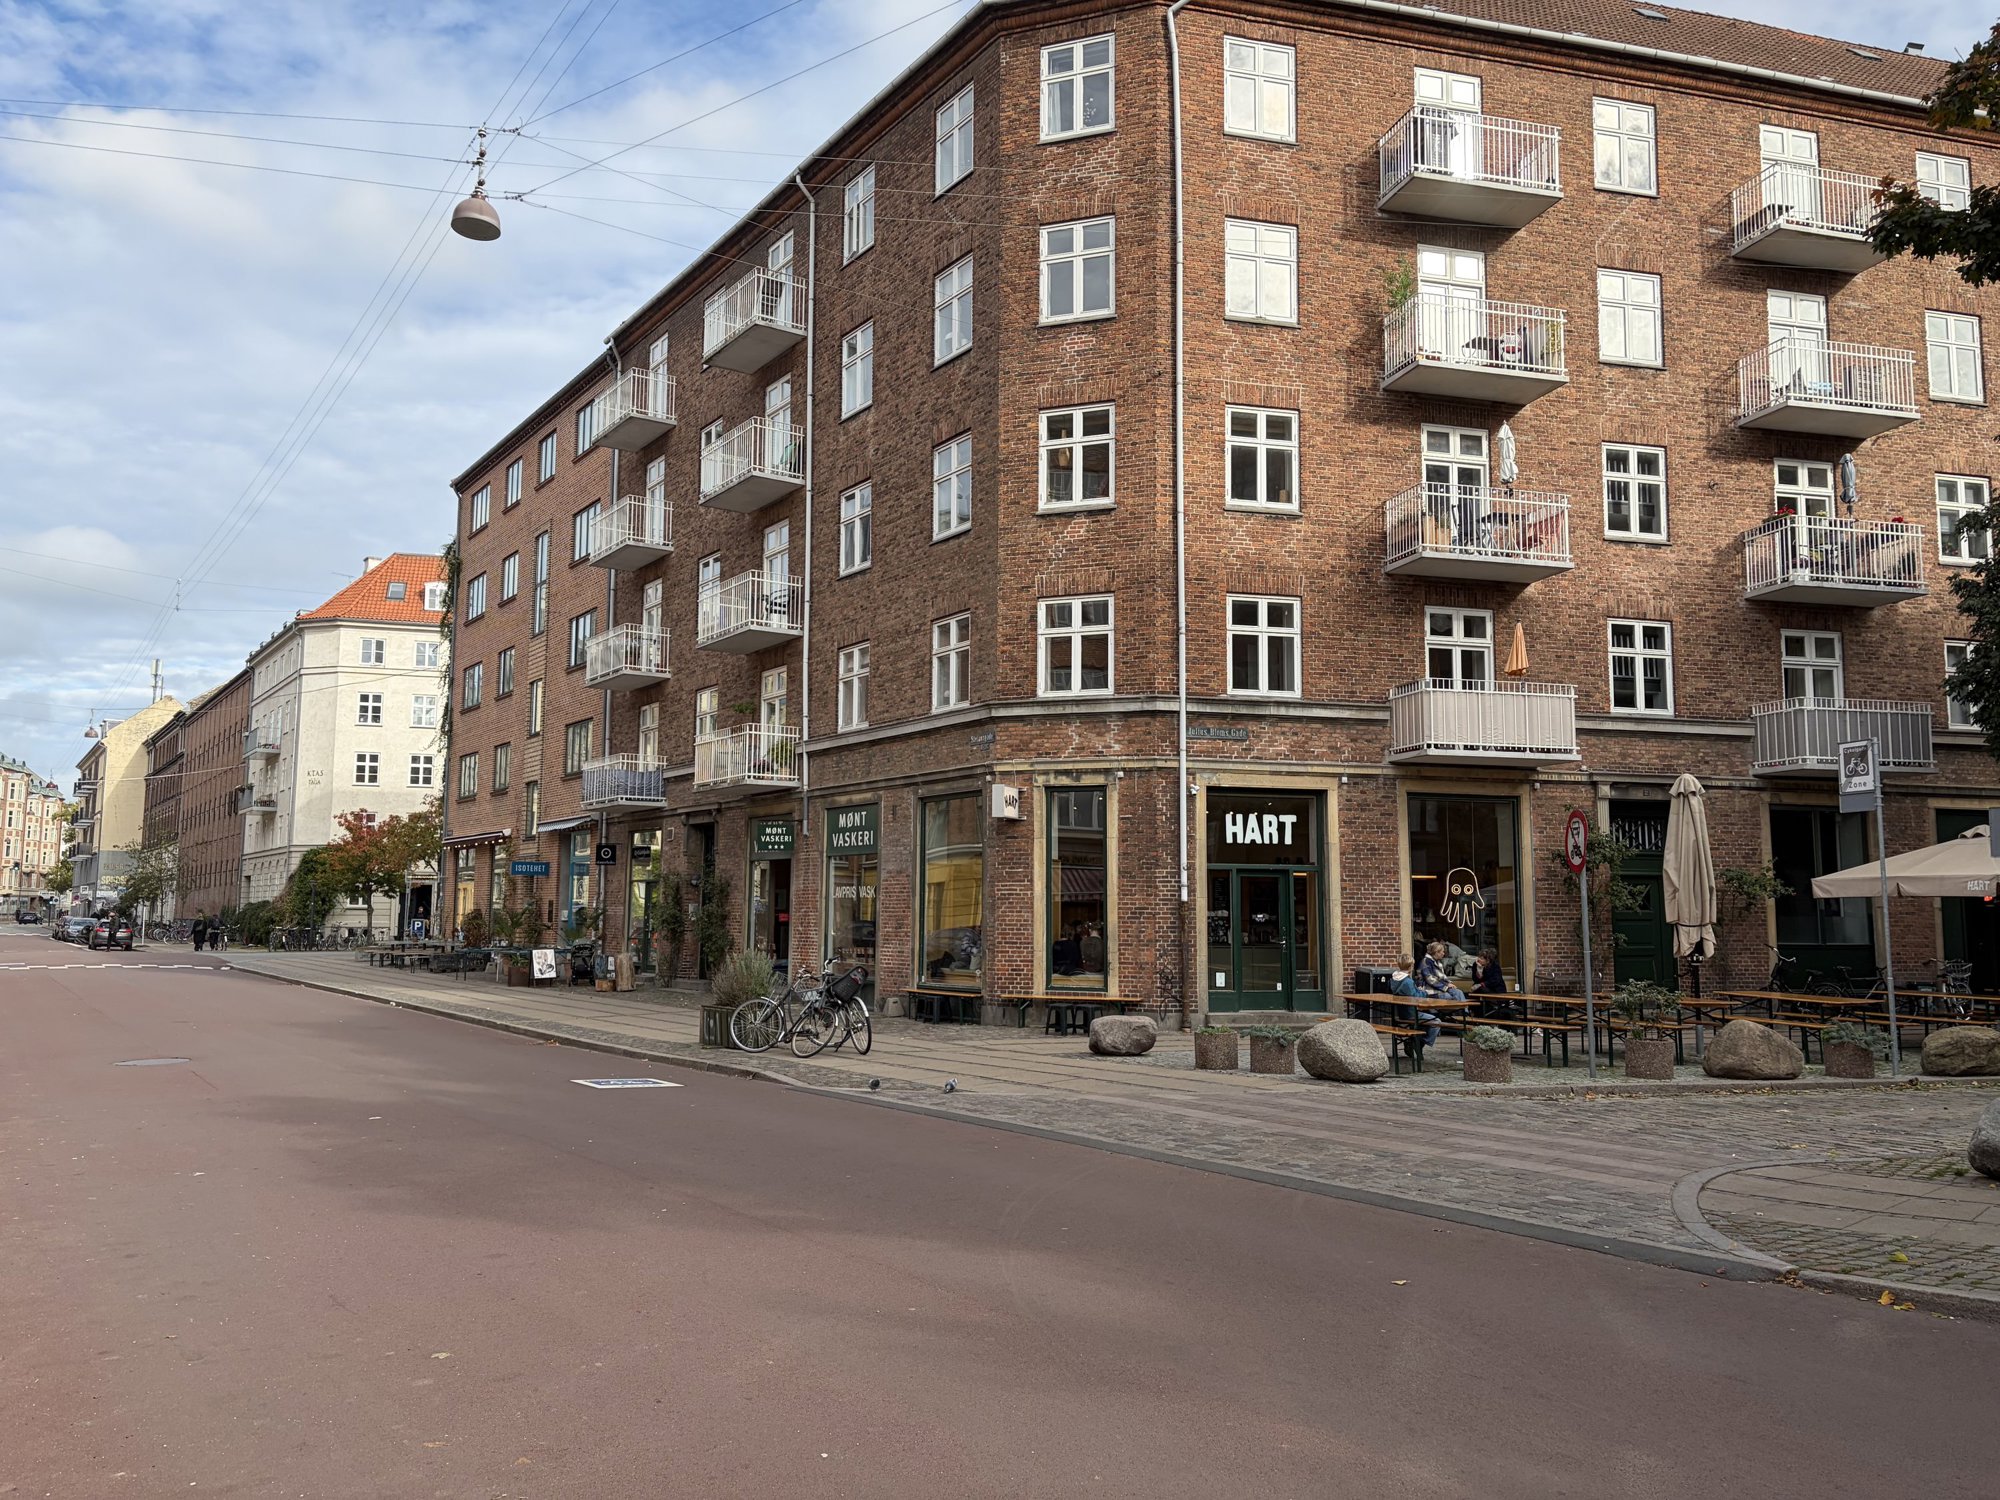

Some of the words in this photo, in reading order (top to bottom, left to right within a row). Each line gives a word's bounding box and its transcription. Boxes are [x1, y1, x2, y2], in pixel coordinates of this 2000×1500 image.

[1848, 780, 1868, 788] Zone
[838, 811, 867, 828] MØNT
[765, 827, 787, 835] MØNT
[1225, 813, 1297, 845] HART
[832, 830, 874, 848] VASKERI
[1967, 880, 1990, 890] HART
[859, 885, 876, 898] VASK
[414, 921, 422, 930] P
